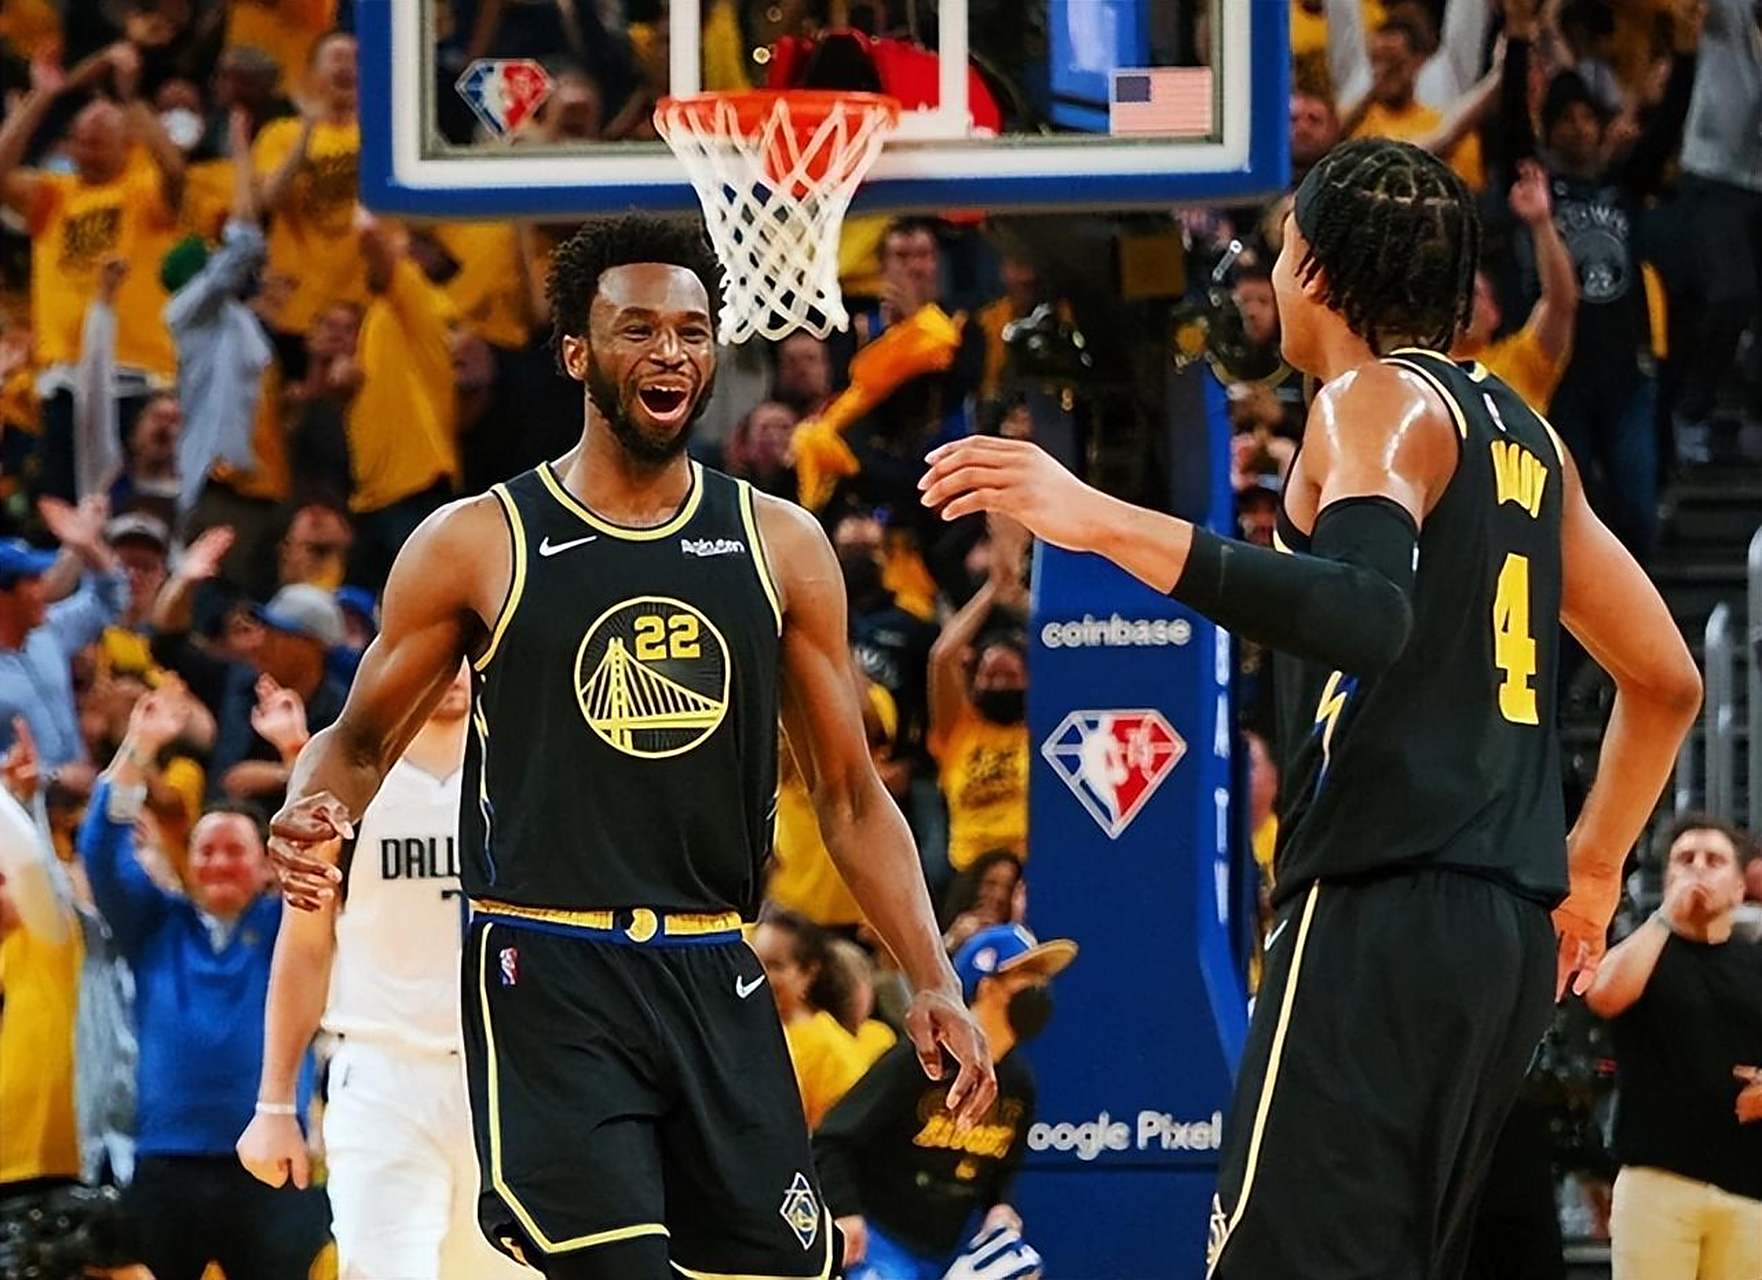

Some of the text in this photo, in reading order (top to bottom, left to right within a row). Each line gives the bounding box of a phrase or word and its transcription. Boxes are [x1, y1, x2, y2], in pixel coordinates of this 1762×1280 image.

[634, 614, 701, 661] 22
[1041, 611, 1192, 648] coinbase
[1493, 552, 1540, 725] 4
[381, 837, 460, 880] DALL
[1027, 1109, 1130, 1161] oogle
[1137, 1109, 1222, 1150] Pixel
